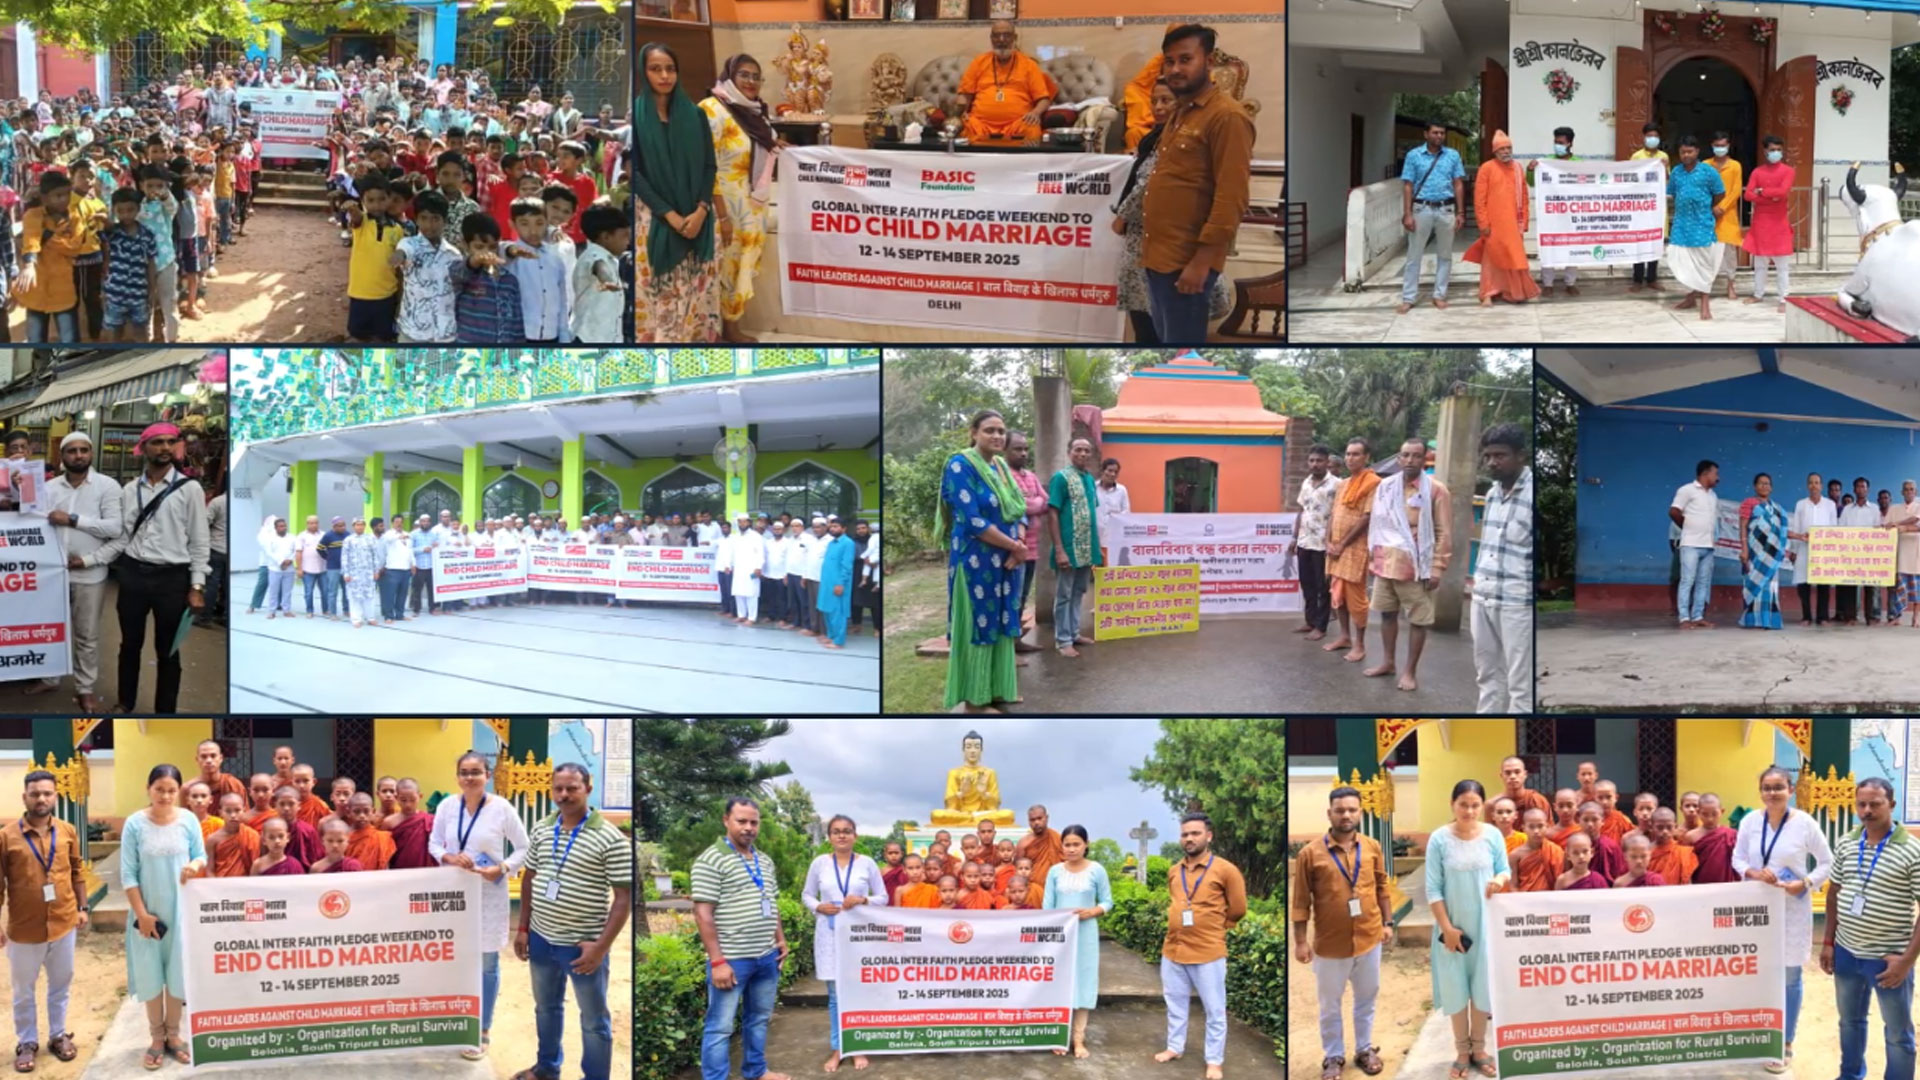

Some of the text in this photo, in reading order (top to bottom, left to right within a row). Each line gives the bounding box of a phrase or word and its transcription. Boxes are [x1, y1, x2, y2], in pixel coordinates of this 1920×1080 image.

[867, 180, 891, 188] INDIA
[921, 170, 975, 183] BASIC
[1038, 173, 1063, 181] CHILD
[920, 183, 975, 191] Foundation
[1037, 183, 1111, 195] FREE WORLD
[812, 201, 1092, 224] GLOBAL INTER FAITH PLEDGE WEEKEND TO
[1544, 200, 1657, 214] END CHILD MARRIAGE
[811, 213, 1092, 247] END CHILD MARRIAGE
[859, 245, 872, 256] 12
[883, 246, 896, 259] 14
[899, 248, 982, 264] SEPTEMBER
[985, 254, 1020, 265] 2025
[796, 268, 974, 292] FAITH LEADERS AGAINST CHILD MARRIAGE
[928, 300, 961, 310] DELHI
[19, 561, 37, 571] TO
[409, 900, 467, 914] FREE WORLD
[1713, 917, 1733, 928] FREE
[214, 929, 455, 951] GLOBAL INTER FAITH PLEDGE WEEKEND TO
[214, 941, 455, 974] END CHILD MARRIAGE
[861, 956, 1055, 966] GLOBAL INTER FAITH PLEDGE WEEKEND TO
[1519, 943, 1758, 966] GLOBAL INTER FAITH PLEDGE WEEKEND TO
[861, 966, 1054, 983] END CHILD MARRIAGE
[1519, 955, 1758, 988] END CHILD MARRIAGE
[260, 981, 273, 992] 12
[282, 980, 295, 991] 14
[297, 976, 369, 990] SEPTEMBER
[371, 974, 400, 986] 2025
[898, 990, 908, 1000] 12
[916, 989, 926, 999] 14
[927, 988, 984, 999] SEPTEMBER
[986, 988, 1009, 998] 2025
[1565, 995, 1578, 1006] 12
[1587, 994, 1599, 1005] 14
[1601, 989, 1673, 1004] SEPTEMBER
[1675, 988, 1704, 1000] 2025
[198, 1005, 363, 1028] FAITH LEADERS AGAINST CHILD MARRIAGE
[207, 1032, 266, 1050] Organized
[269, 1031, 283, 1045] by
[297, 1025, 369, 1043] Organization
[371, 1023, 387, 1036] for
[390, 1021, 420, 1034] Rural
[423, 1019, 468, 1032] Survival
[984, 1026, 1060, 1037] for Rural Survival
[251, 1036, 424, 1057] Belonia, South Tripura District
[1513, 1045, 1571, 1063] Organized
[1573, 1045, 1588, 1059] by
[1602, 1039, 1672, 1057] Organization
[1675, 1037, 1691, 1049] for
[1695, 1035, 1723, 1048] Rural
[1726, 1032, 1772, 1045] Survival
